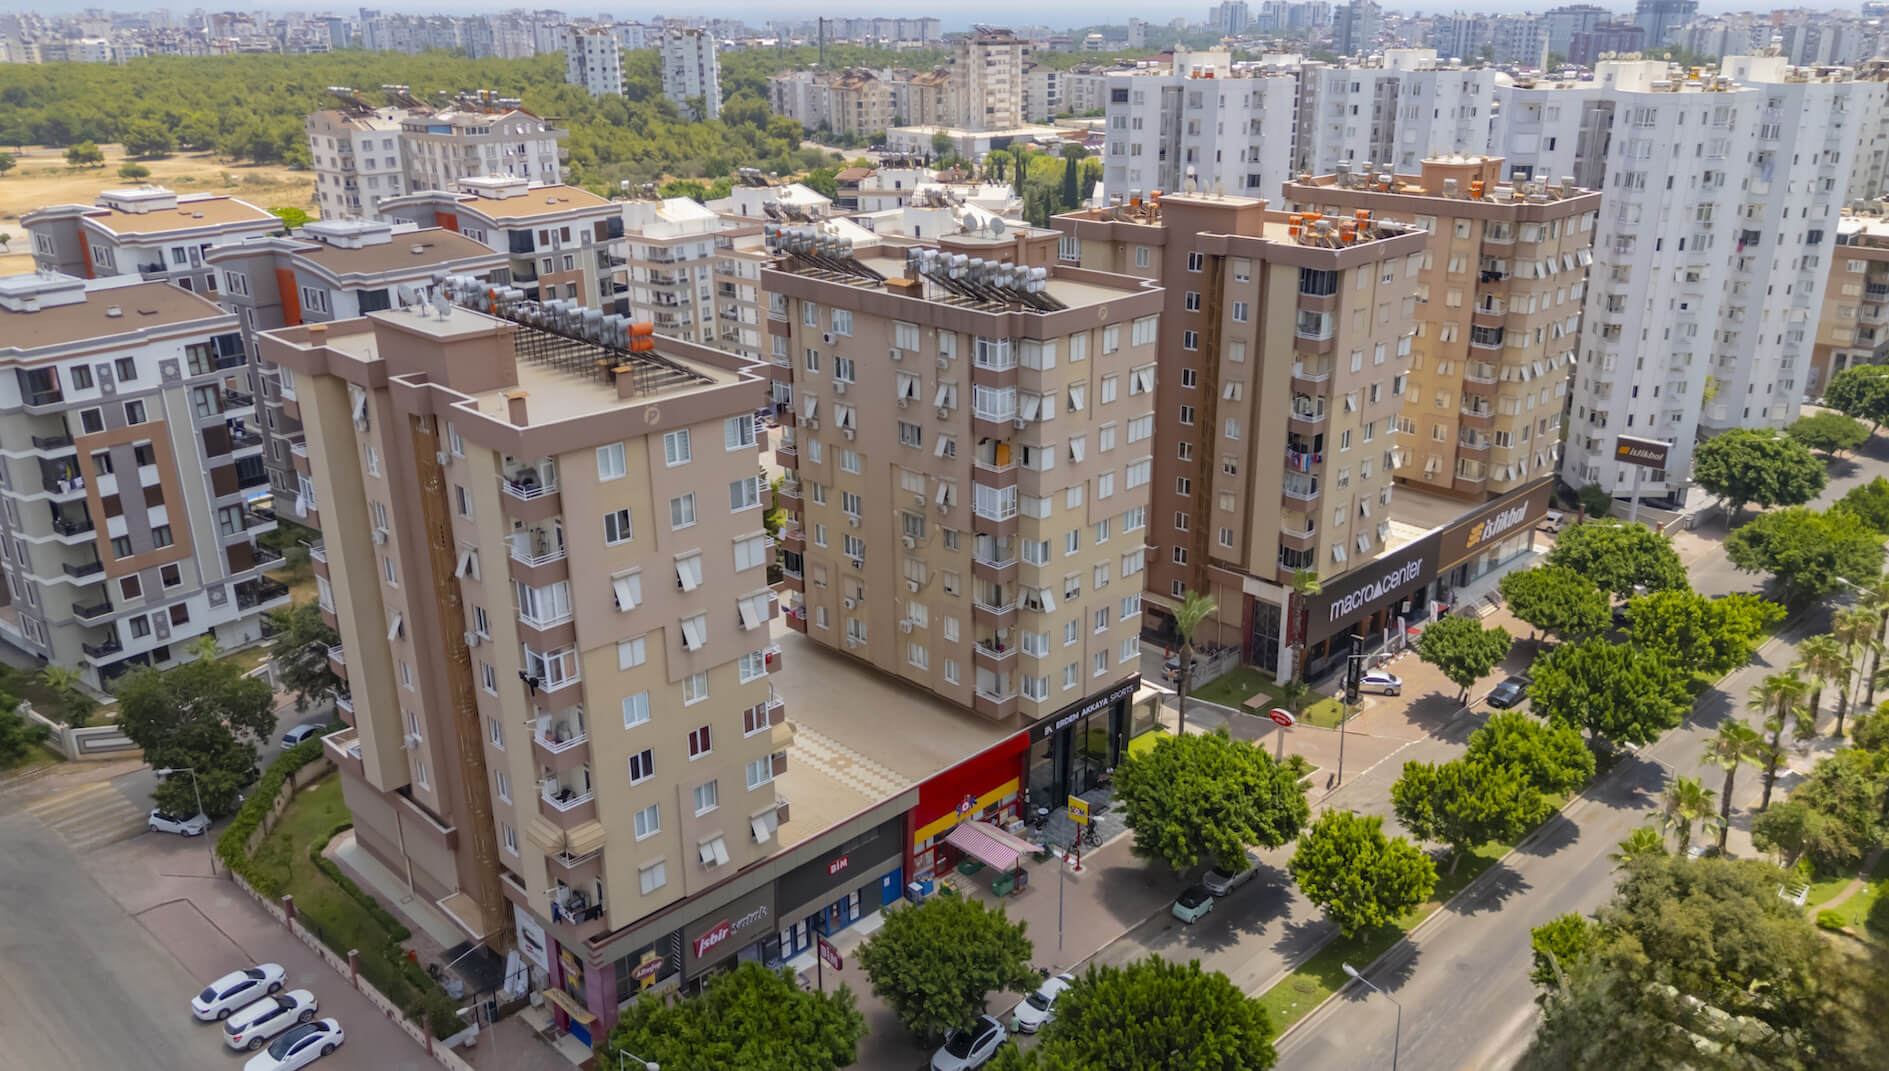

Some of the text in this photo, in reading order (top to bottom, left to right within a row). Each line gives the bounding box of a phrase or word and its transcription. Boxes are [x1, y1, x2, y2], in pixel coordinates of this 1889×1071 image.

[1629, 447, 1665, 461] istikbal
[1481, 499, 1529, 541] istikbal
[1110, 685, 1134, 702] SPORTS
